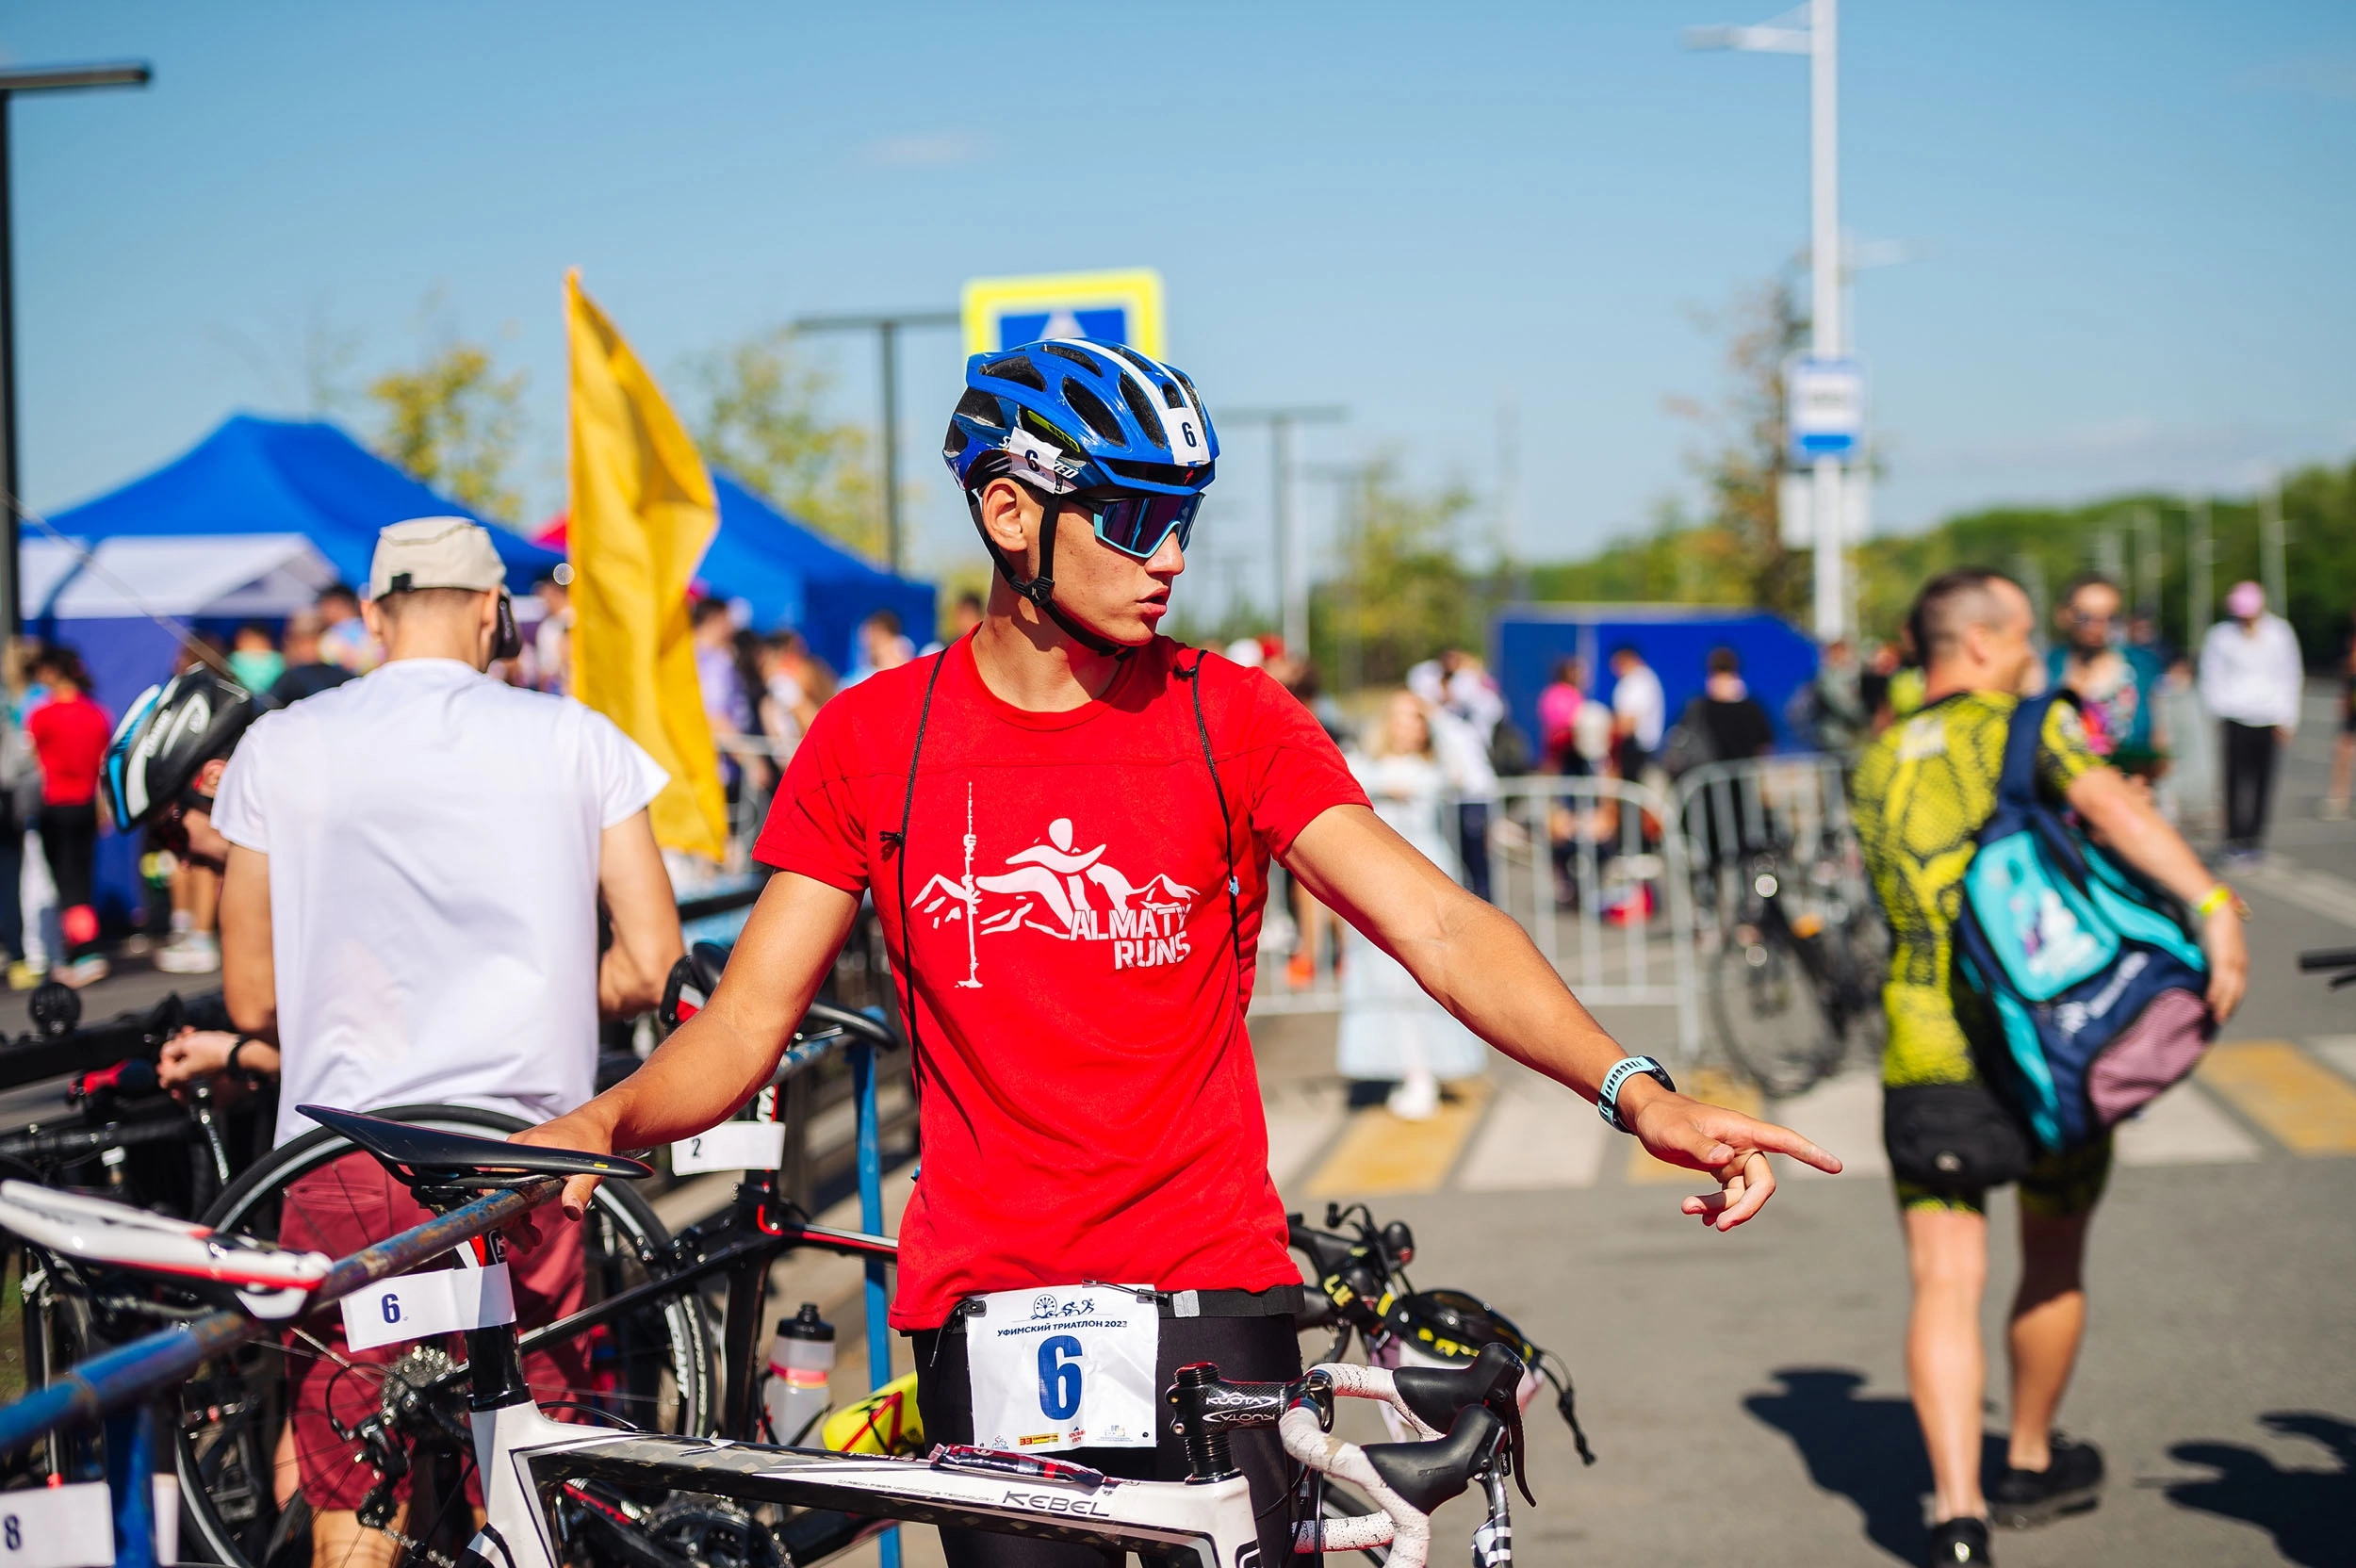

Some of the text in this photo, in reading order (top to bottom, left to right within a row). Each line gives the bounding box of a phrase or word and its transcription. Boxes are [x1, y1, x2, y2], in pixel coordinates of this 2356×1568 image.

[1181, 421, 1197, 448] 6
[1024, 449, 1040, 472] 6
[1070, 903, 1192, 941] ALMATY
[1114, 931, 1191, 971] RUNS
[692, 1137, 702, 1159] 2
[381, 1293, 401, 1324] 6
[997, 1320, 1128, 1337] УФИМСКИЙ ТРИАТЛОН 2023
[670, 1329, 690, 1399] GIANT
[1038, 1334, 1083, 1421] 6
[1205, 1396, 1263, 1405] KUOTA
[1002, 1491, 1110, 1517] KEBEL
[3, 1513, 22, 1551] 8
